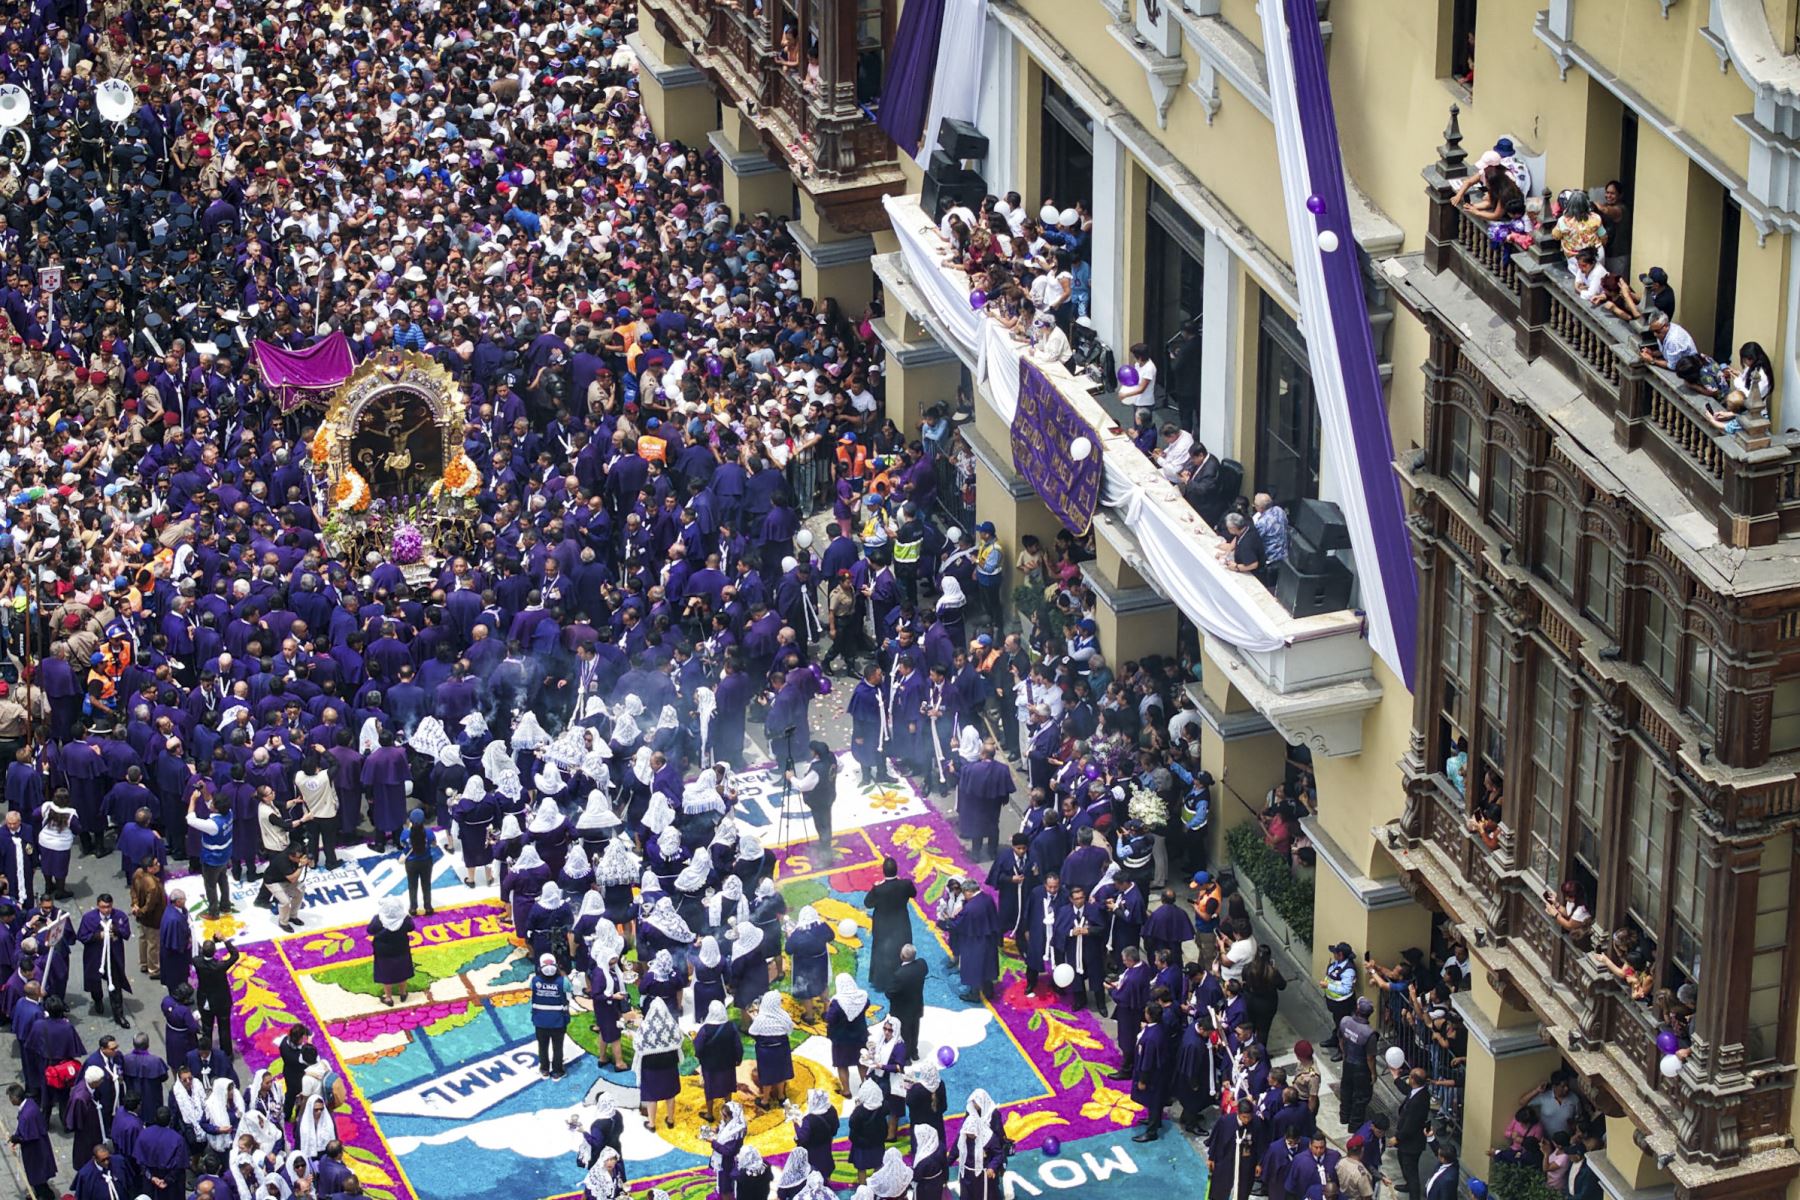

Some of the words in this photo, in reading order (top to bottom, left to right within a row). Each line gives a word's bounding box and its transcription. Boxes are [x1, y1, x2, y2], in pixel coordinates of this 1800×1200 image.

[0, 87, 20, 97] AP
[103, 81, 130, 93] FAP
[418, 1052, 539, 1104] GMML
